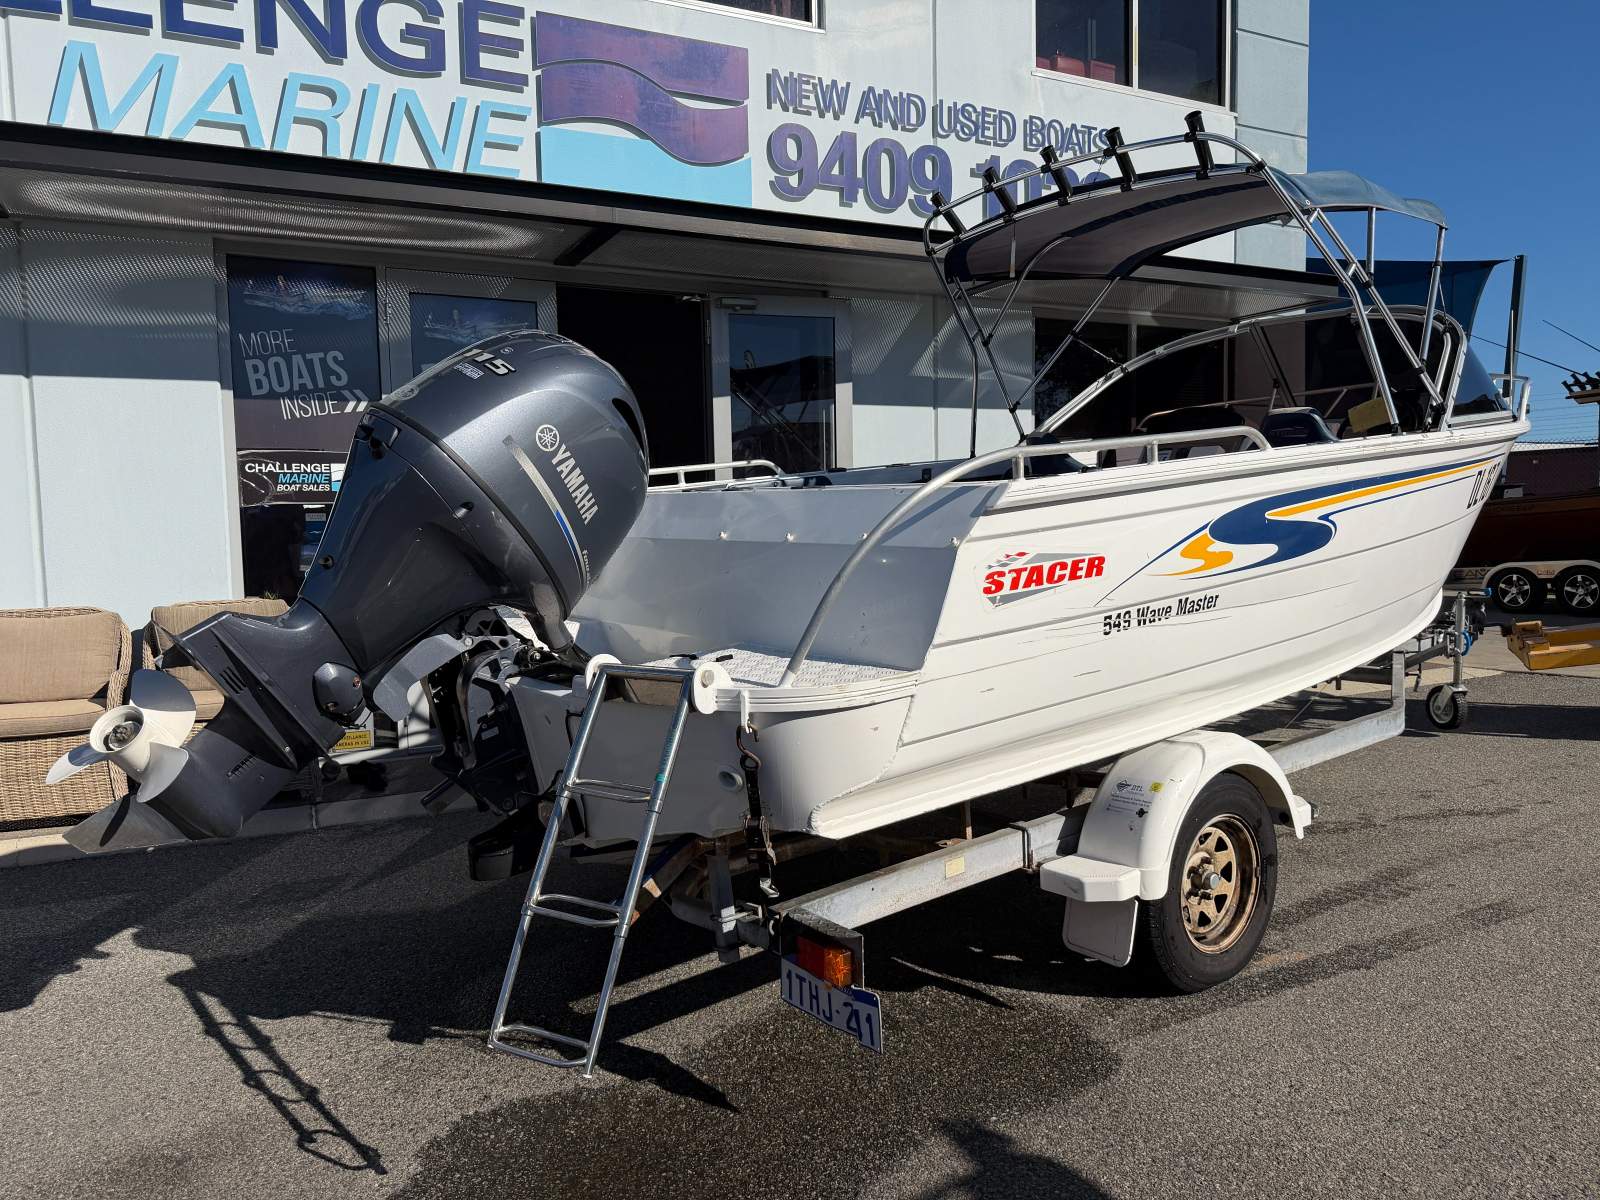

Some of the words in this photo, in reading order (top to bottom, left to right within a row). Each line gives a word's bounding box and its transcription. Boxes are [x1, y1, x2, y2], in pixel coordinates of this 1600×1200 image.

[48, 40, 532, 179] MARINE
[766, 68, 851, 121] NEW
[855, 85, 927, 133] AND
[932, 98, 1016, 148] USED
[766, 122, 953, 219] 9409
[238, 328, 297, 357] MORE
[244, 350, 349, 396] BOATS
[280, 390, 341, 420] INSIDE
[244, 462, 330, 473] CHALLENGE
[276, 484, 301, 492] BOAT
[302, 484, 330, 492] SALES
[278, 473, 330, 484] MARINE
[551, 443, 600, 526] YAMAHA
[982, 555, 1107, 595] STACER
[1103, 610, 1132, 636] 549
[1136, 605, 1173, 627] Wave
[1175, 594, 1220, 616] Master
